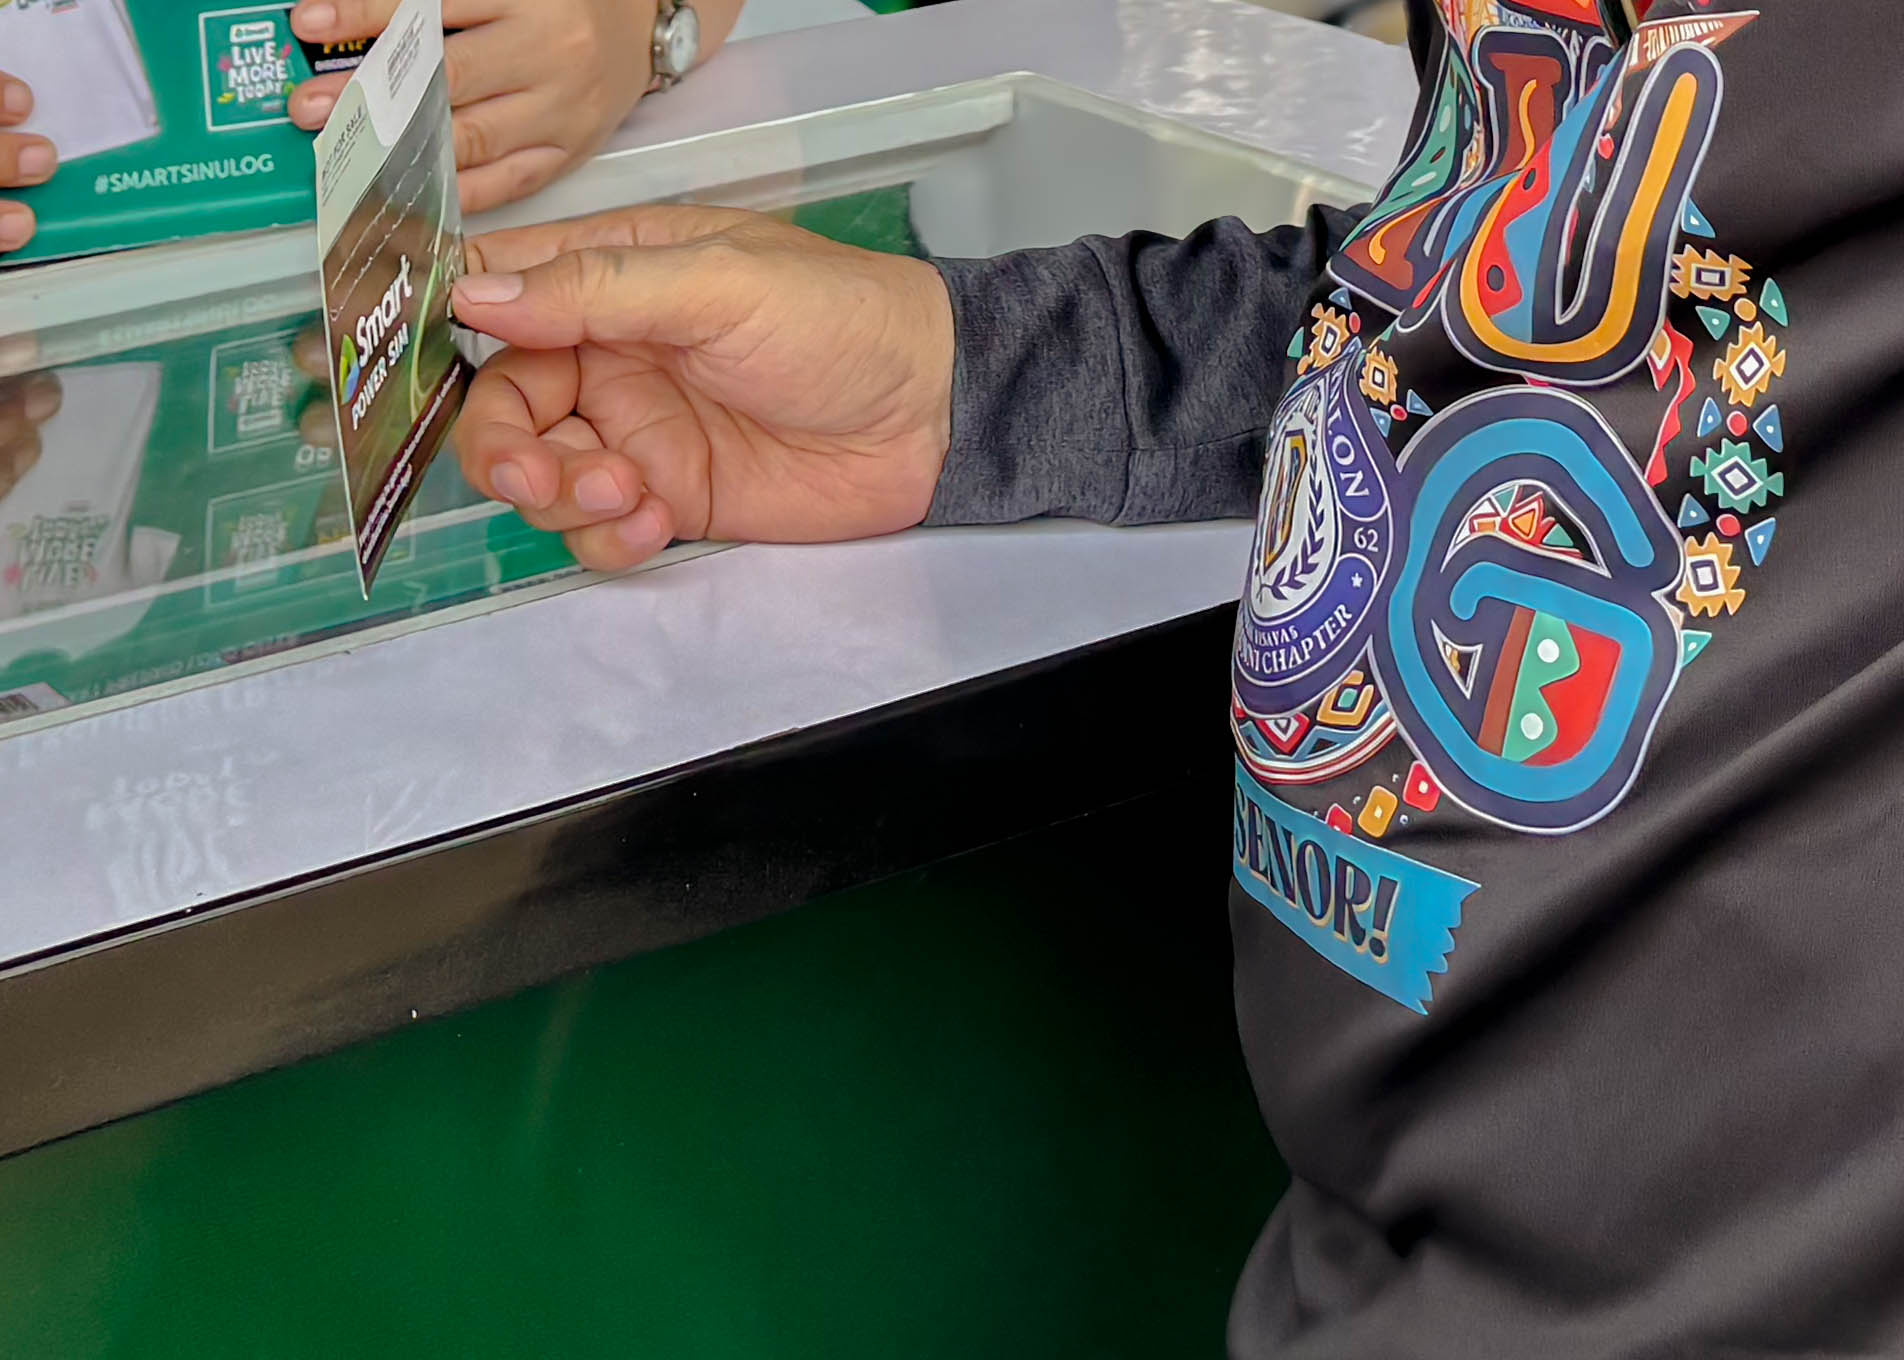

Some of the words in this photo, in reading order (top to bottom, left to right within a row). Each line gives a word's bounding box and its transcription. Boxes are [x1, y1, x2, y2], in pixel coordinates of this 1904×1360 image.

[230, 41, 277, 66] LIVE
[227, 60, 289, 88] MORE
[93, 153, 276, 195] #SMARTSINULOG
[355, 253, 414, 369] Smart
[1353, 527, 1380, 553] 62
[1261, 603, 1353, 674] CHAPTER
